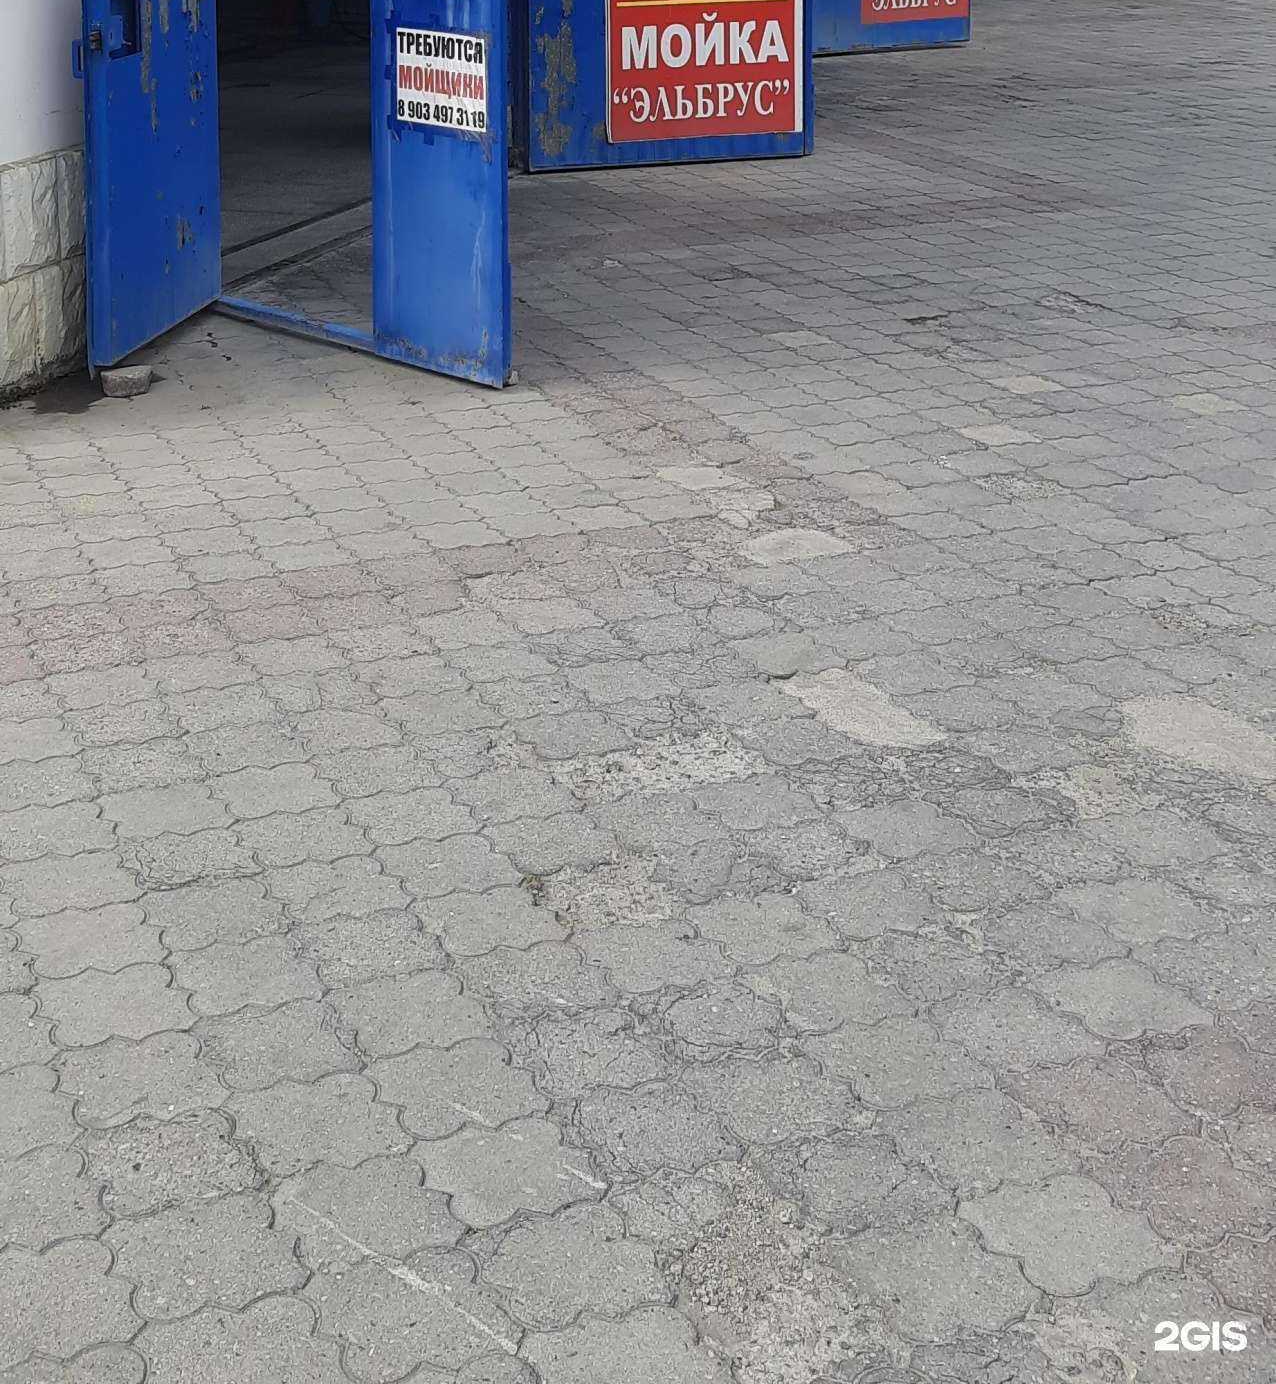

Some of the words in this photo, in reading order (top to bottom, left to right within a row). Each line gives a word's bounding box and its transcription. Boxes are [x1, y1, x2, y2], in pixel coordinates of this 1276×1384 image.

[397, 31, 483, 64] ТРЕБУЮТСЯ
[621, 11, 789, 70] МОЙКА
[398, 62, 484, 100] МОЙЩИКИ
[398, 99, 405, 117] 8
[408, 100, 430, 120] 903
[433, 104, 453, 124] 497
[456, 107, 485, 129] 3119
